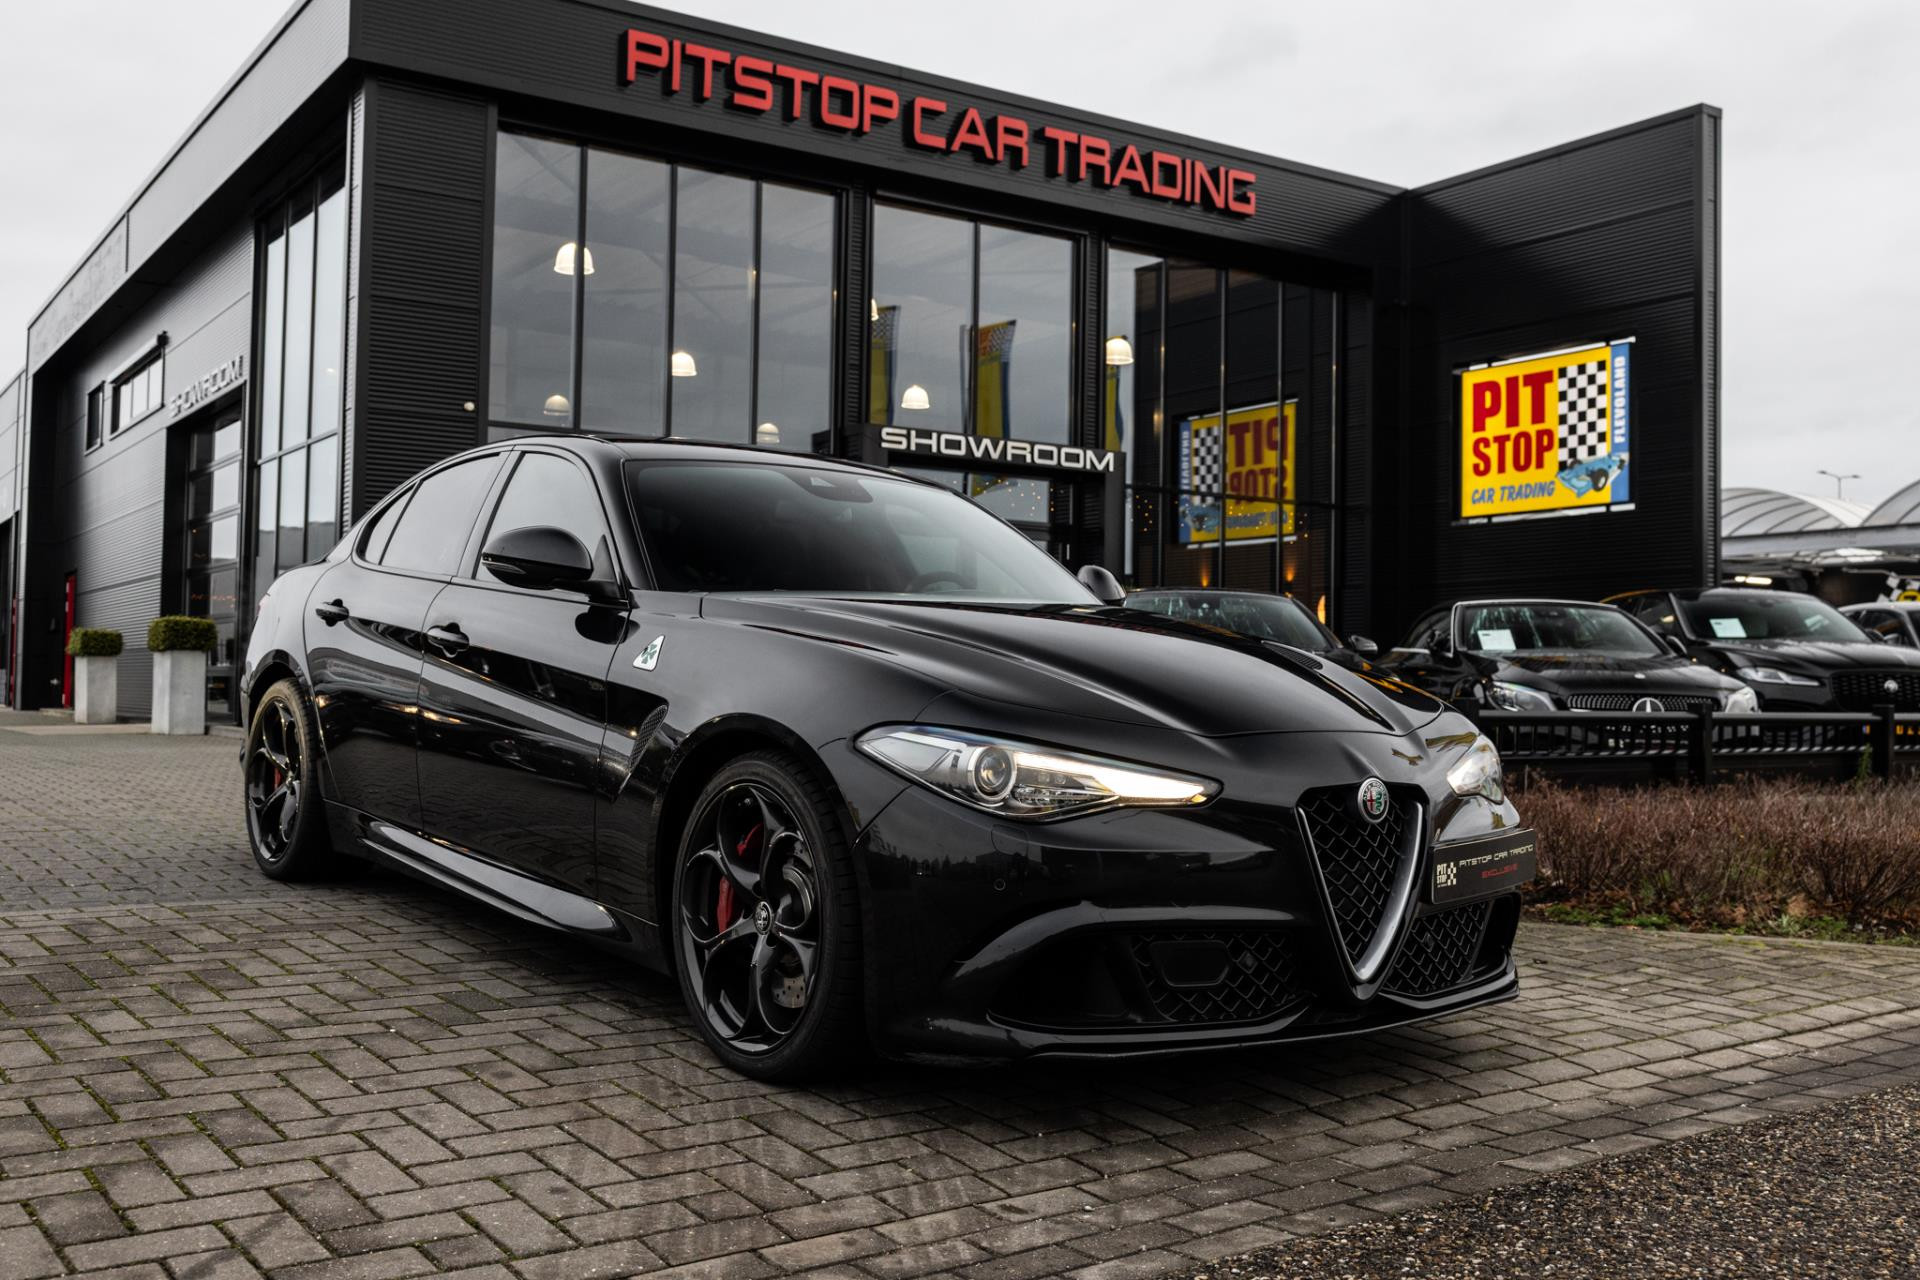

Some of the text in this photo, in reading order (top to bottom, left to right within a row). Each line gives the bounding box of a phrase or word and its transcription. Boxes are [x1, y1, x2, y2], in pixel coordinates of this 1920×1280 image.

[625, 28, 1257, 216] PITSTOP CAR TRADING
[1472, 369, 1555, 433] PIT
[1613, 355, 1627, 444] FLEVOLAND
[880, 426, 1115, 473] SHOWROOM
[1472, 428, 1556, 478] STOP
[1471, 480, 1556, 505] CAR TRADING
